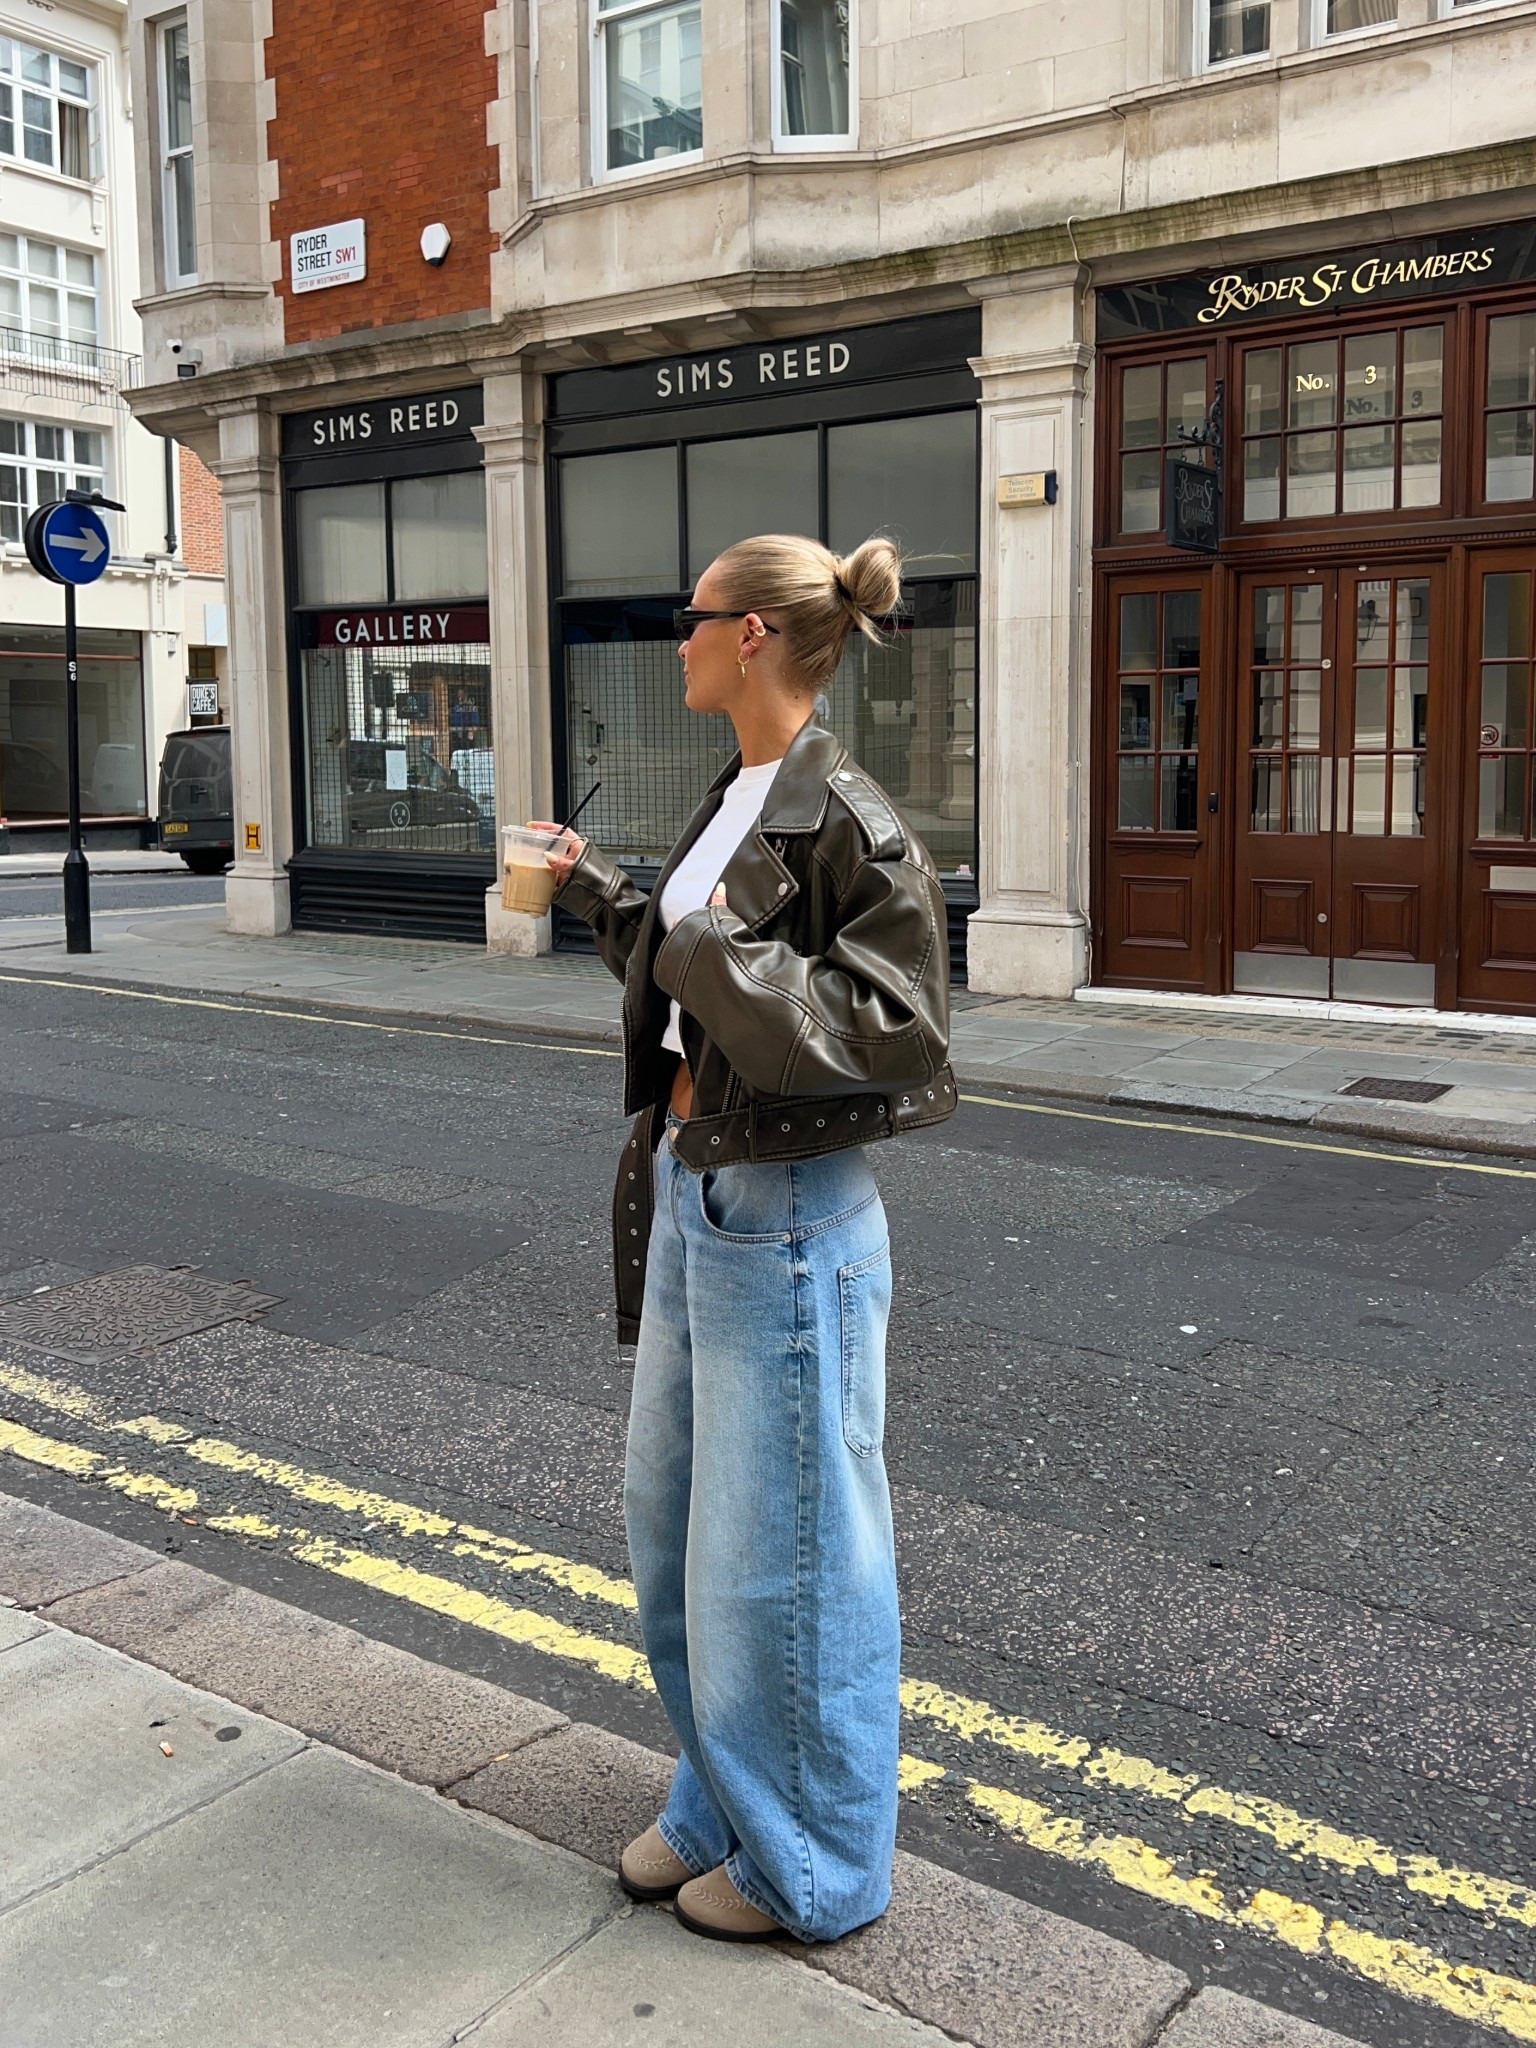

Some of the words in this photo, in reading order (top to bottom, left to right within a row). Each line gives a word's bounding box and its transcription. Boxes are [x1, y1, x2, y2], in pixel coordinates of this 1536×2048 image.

[297, 234, 328, 254] RYDER
[297, 251, 332, 272] STREET
[335, 246, 356, 264] SW1
[298, 281, 309, 289] CITY
[316, 272, 350, 284] WESTMINSTER
[1197, 276, 1306, 323] RYDER
[1351, 248, 1495, 294] CHAMBERS
[656, 358, 734, 398] SIMS
[759, 342, 850, 383] REED
[1295, 373, 1330, 392] No.
[1364, 365, 1378, 385] 3
[313, 412, 372, 445] SIMS
[390, 400, 459, 434] REED
[1175, 468, 1204, 500] RYDER
[1181, 498, 1214, 525] CHAMBERS
[335, 613, 450, 644] GALLERY
[68, 661, 77, 672] S
[70, 672, 77, 682] 6
[192, 687, 215, 700] DUKE'S
[245, 824, 261, 849] H
